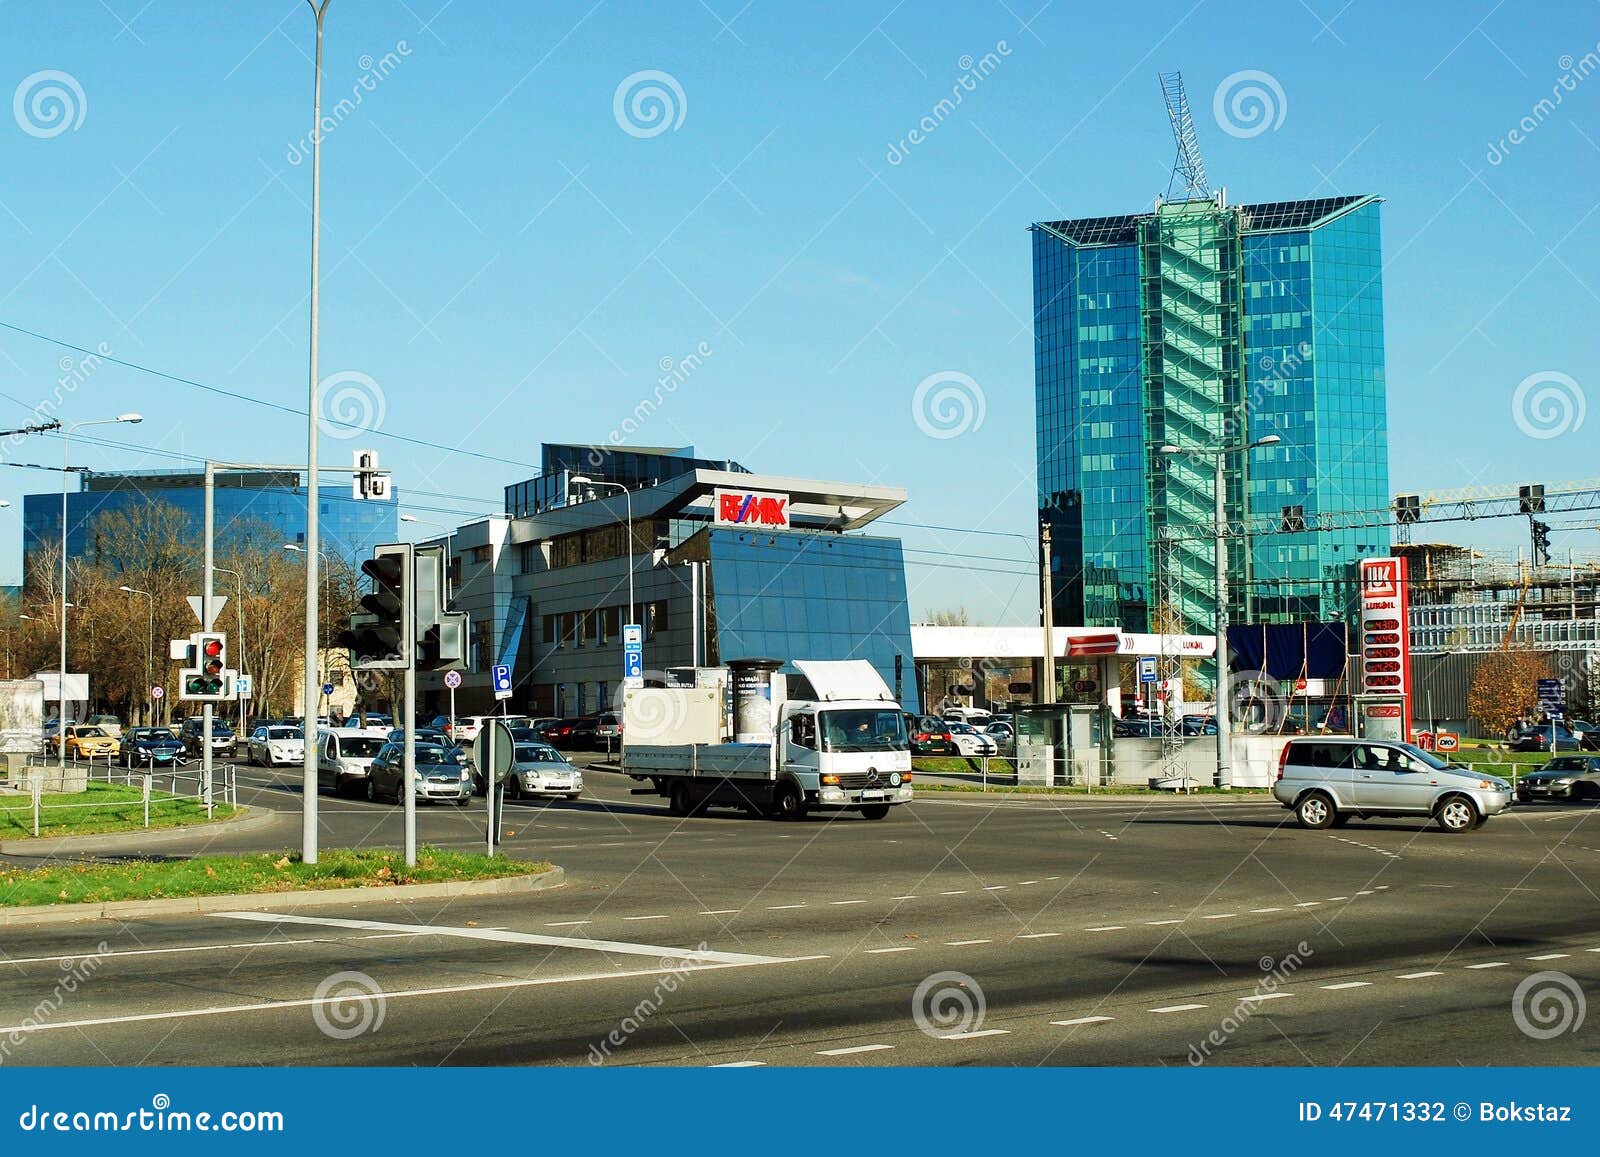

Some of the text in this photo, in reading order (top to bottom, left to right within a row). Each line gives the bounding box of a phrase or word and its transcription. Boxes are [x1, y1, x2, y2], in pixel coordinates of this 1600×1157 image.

[1365, 601, 1395, 610] LUKOIL
[1183, 641, 1204, 649] LUKOIL
[629, 653, 639, 667] P
[497, 667, 507, 681] P
